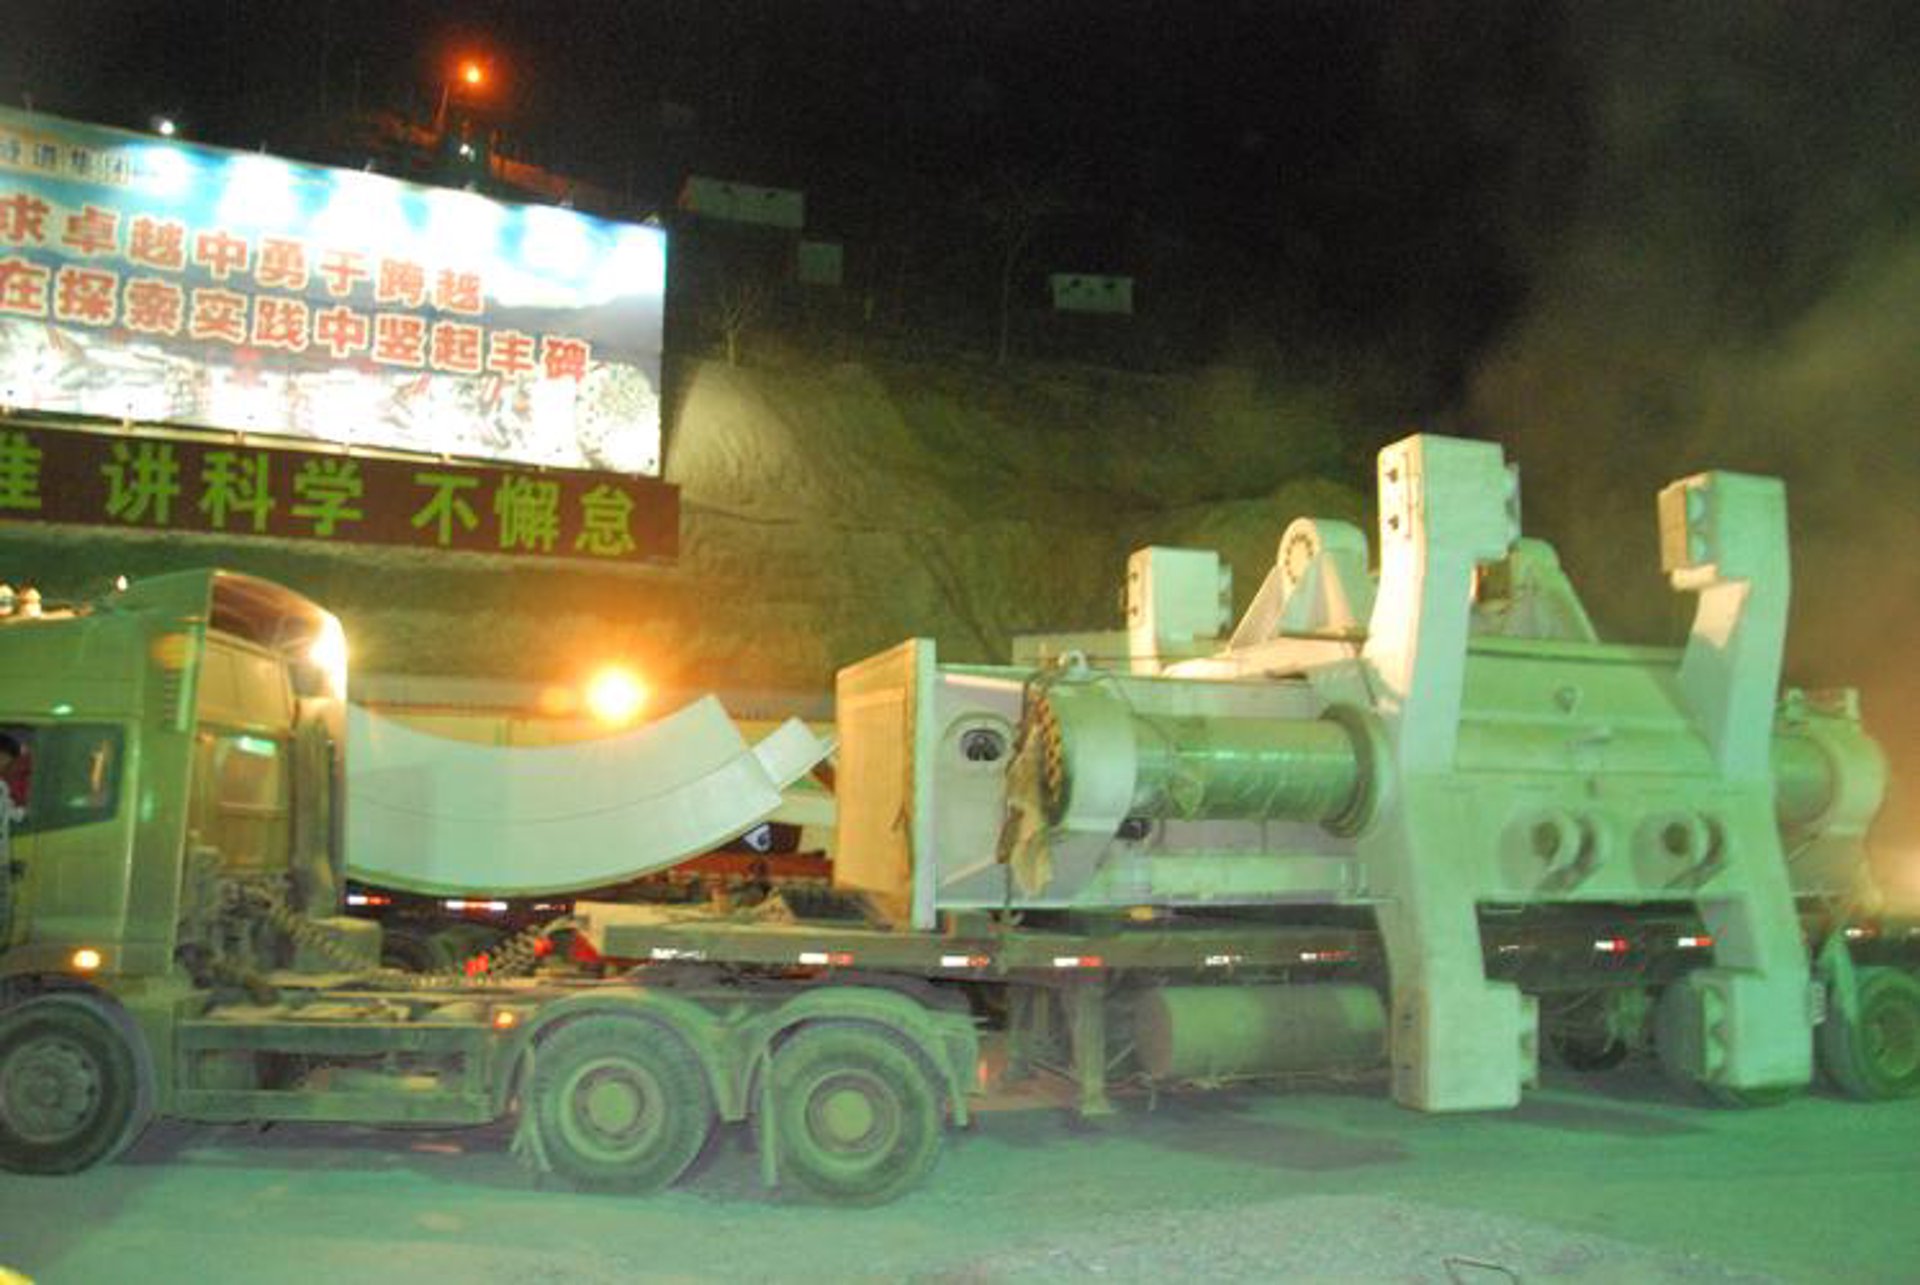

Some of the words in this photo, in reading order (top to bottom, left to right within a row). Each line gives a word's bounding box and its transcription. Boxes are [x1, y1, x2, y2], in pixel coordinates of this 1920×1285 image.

[103, 442, 364, 537] 讲科学
[410, 472, 635, 556] 不懈怠
